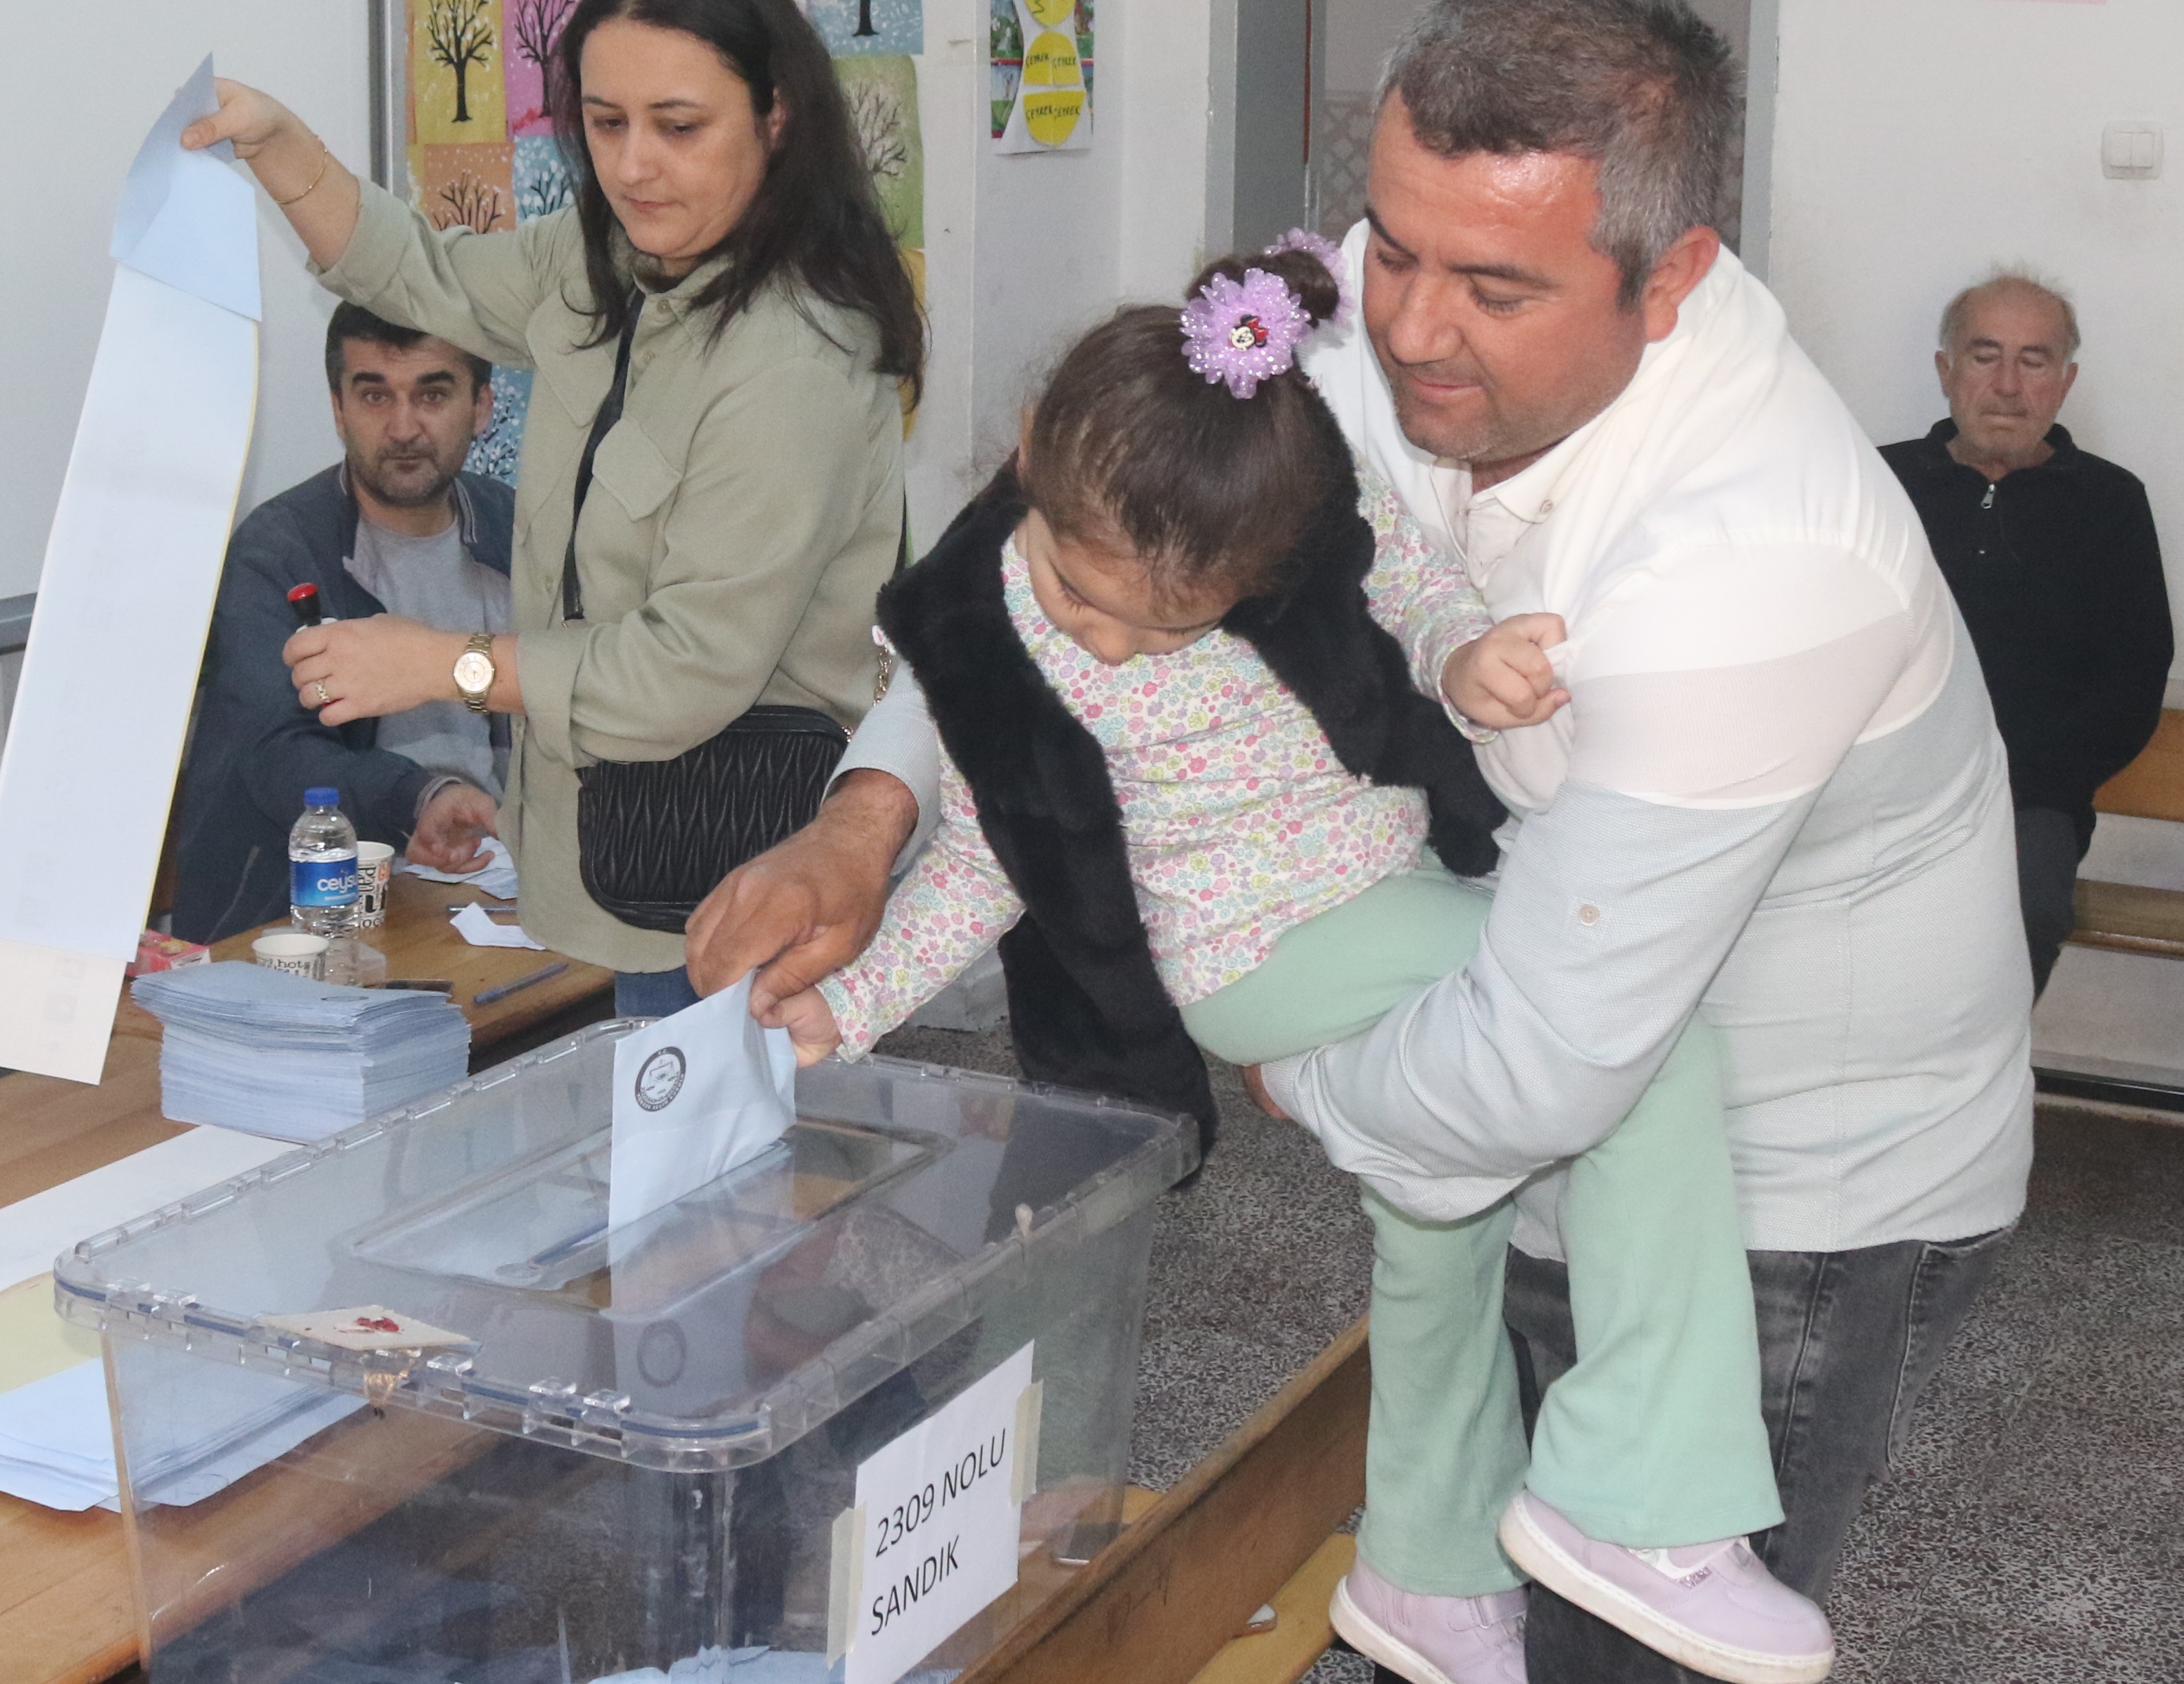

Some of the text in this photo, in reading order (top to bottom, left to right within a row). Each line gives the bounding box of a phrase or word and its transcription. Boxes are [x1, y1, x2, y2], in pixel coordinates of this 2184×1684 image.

[277, 959, 304, 968] hot
[876, 1428, 1006, 1557] 2309 NOLU
[871, 1535, 959, 1636] SANDIK
